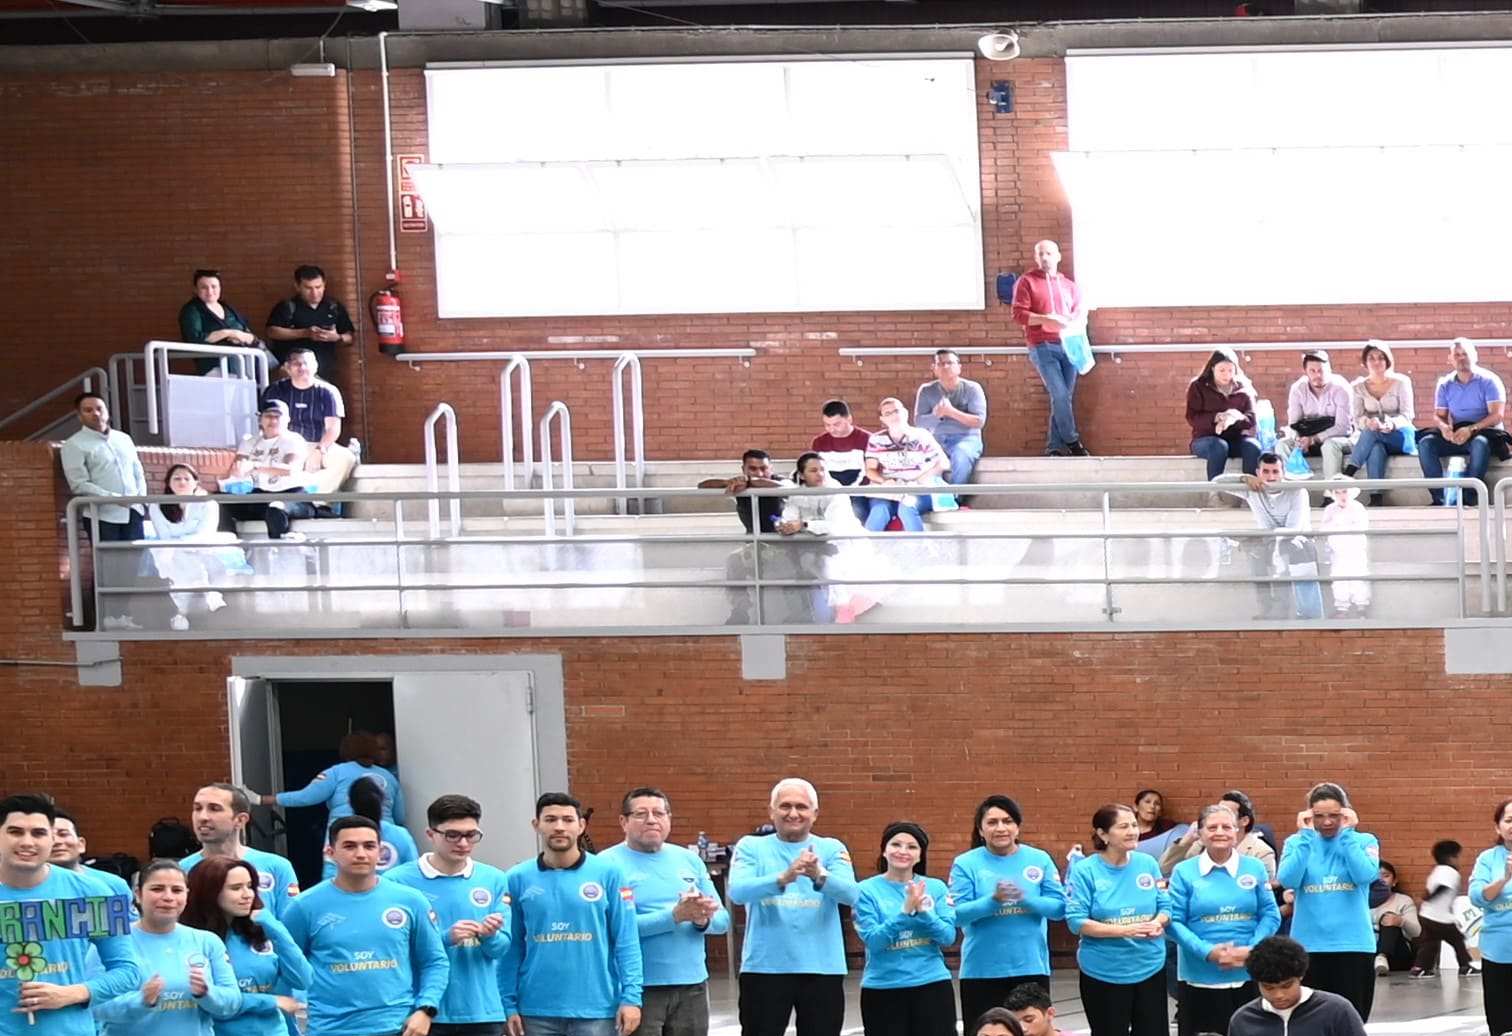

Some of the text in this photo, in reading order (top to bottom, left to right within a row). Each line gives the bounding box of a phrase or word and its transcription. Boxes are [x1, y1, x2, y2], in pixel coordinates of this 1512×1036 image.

[1321, 876, 1337, 885] SOY
[1120, 907, 1135, 916] SOY
[551, 922, 570, 932] SOY
[354, 951, 374, 961] SOY
[330, 959, 398, 974] VOLUNTARIO
